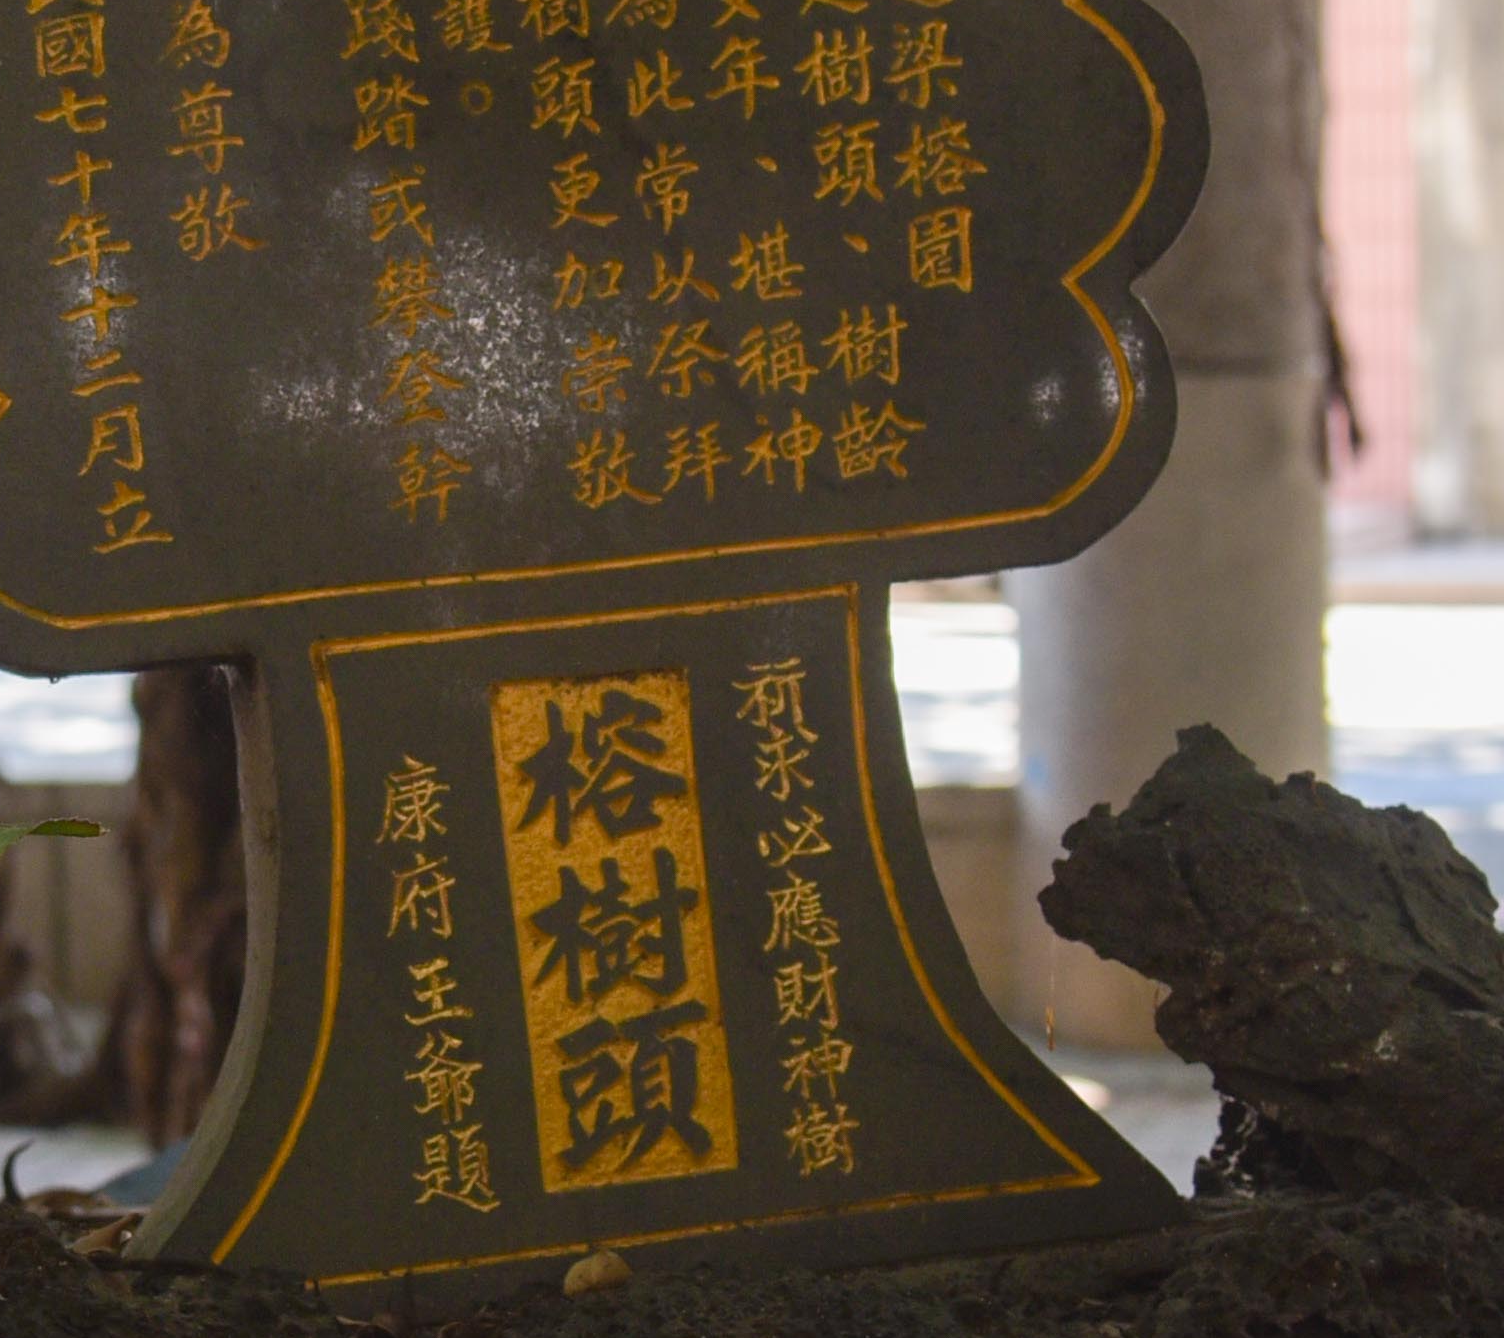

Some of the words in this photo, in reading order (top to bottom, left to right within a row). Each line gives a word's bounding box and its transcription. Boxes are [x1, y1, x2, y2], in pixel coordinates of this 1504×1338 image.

[375, 754, 501, 1214] 康府王爺題
[516, 689, 714, 1175] 榕樹頭
[733, 657, 861, 1178] 祈求必應財神樹
